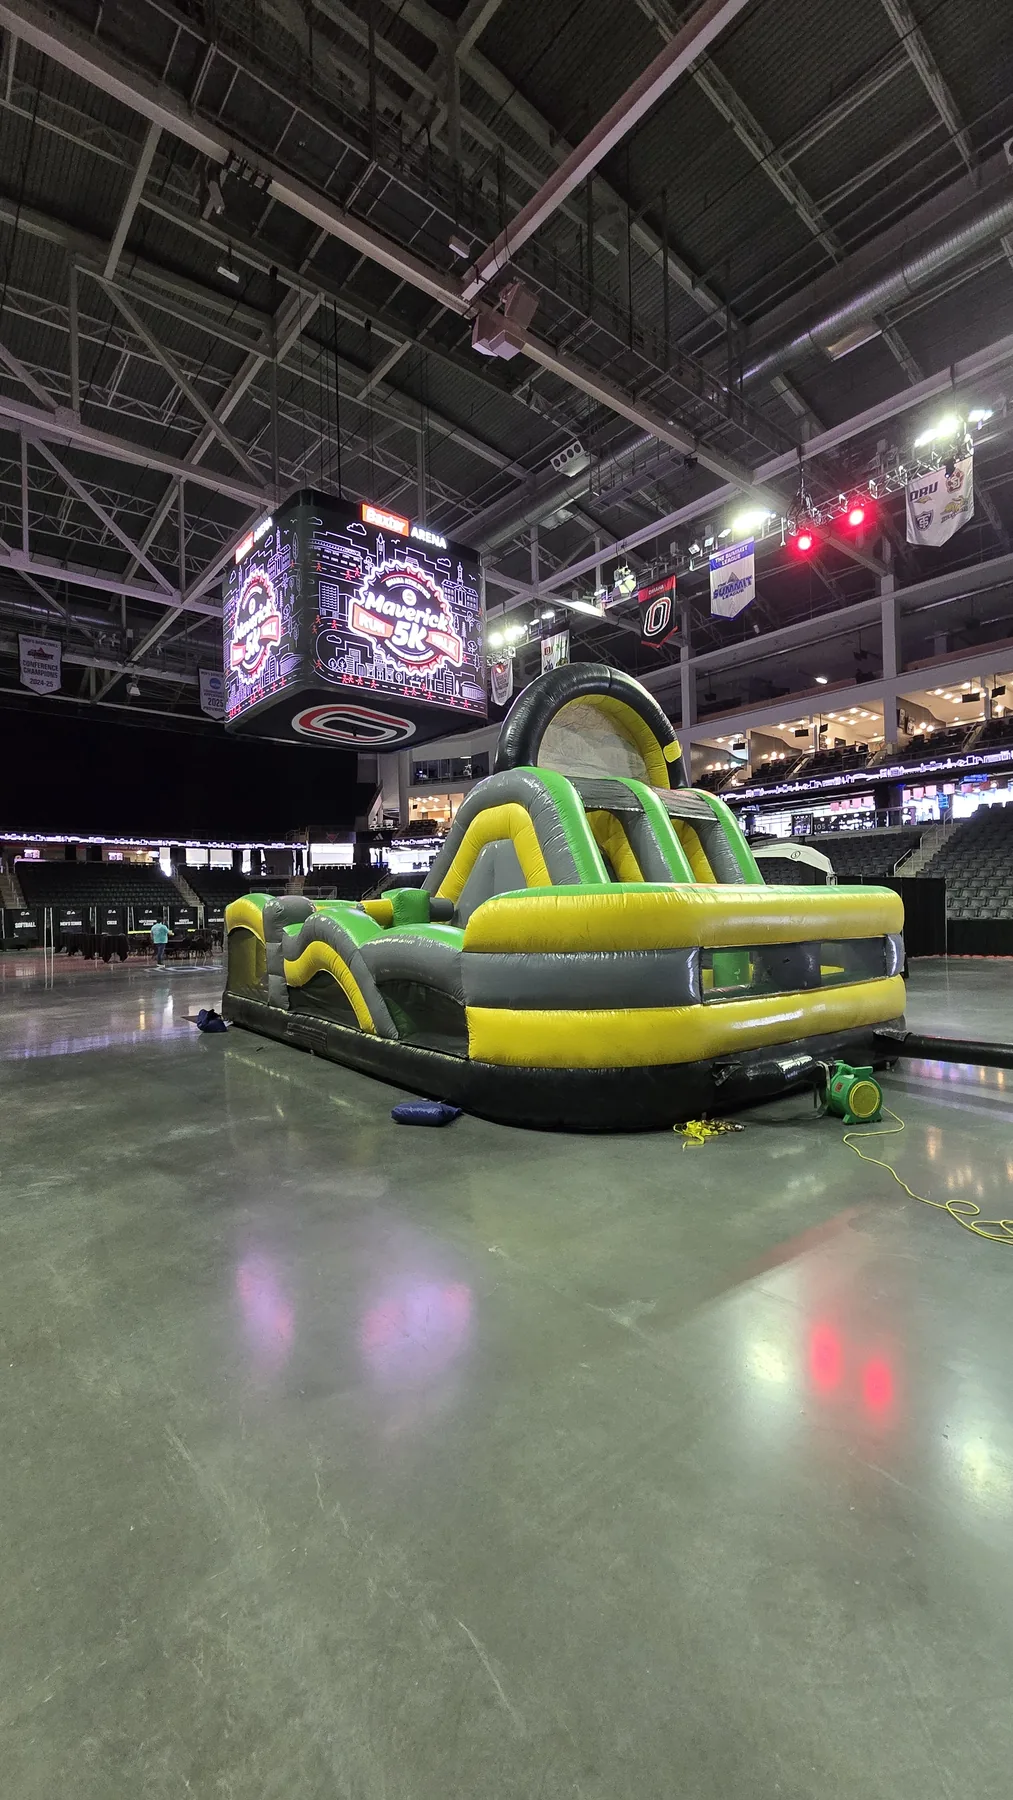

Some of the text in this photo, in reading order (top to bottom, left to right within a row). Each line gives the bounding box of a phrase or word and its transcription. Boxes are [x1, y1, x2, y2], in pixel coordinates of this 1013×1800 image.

[366, 508, 447, 550] Baxter ARENA
[725, 545, 748, 559] SUMMIT
[721, 553, 740, 566] LEAGUE
[648, 584, 665, 595] OMAHA
[713, 575, 753, 600] SUMMIT
[722, 588, 744, 600] LEAGUE
[364, 591, 450, 632] Maverick
[235, 602, 272, 641] Maverick
[358, 613, 386, 635] RUN
[391, 621, 428, 651] 5K
[244, 627, 261, 660] 5K
[432, 633, 457, 655] WALK
[23, 659, 58, 671] CONFERENCE
[23, 667, 58, 679] CHAMPIONS
[29, 678, 54, 688] 2024-25
[207, 697, 224, 708] 2025
[14, 921, 36, 929] SOFTBALL
